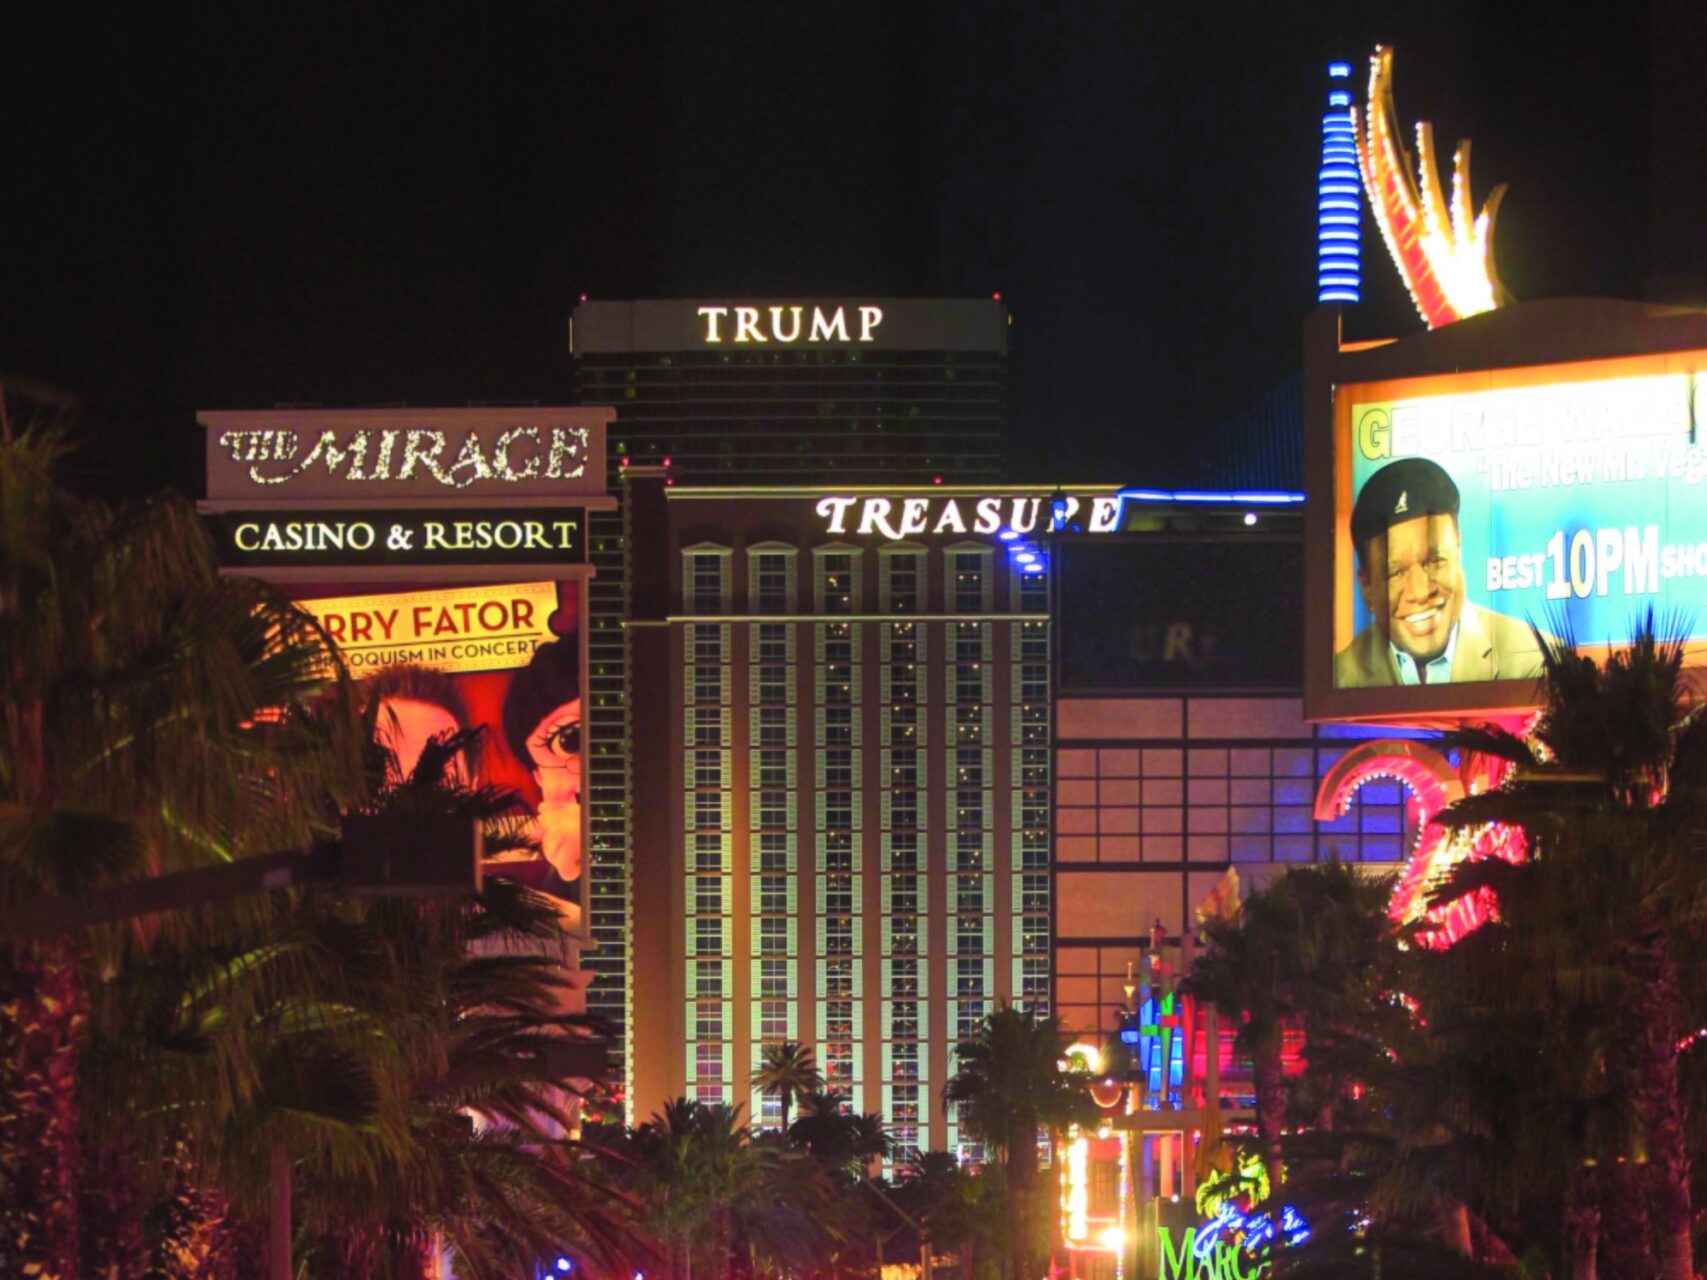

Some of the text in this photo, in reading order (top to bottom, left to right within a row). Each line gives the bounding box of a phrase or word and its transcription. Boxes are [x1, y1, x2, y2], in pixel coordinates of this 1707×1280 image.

[697, 306, 883, 342] TRUMP
[219, 426, 591, 488] THE MIRAGE
[234, 520, 577, 551] CASINO & RESORT
[1486, 552, 1545, 592] BEST
[1546, 524, 1659, 600] 10PM
[412, 598, 535, 638] FATOR
[428, 643, 447, 661] IN
[451, 638, 539, 660] CONCERT
